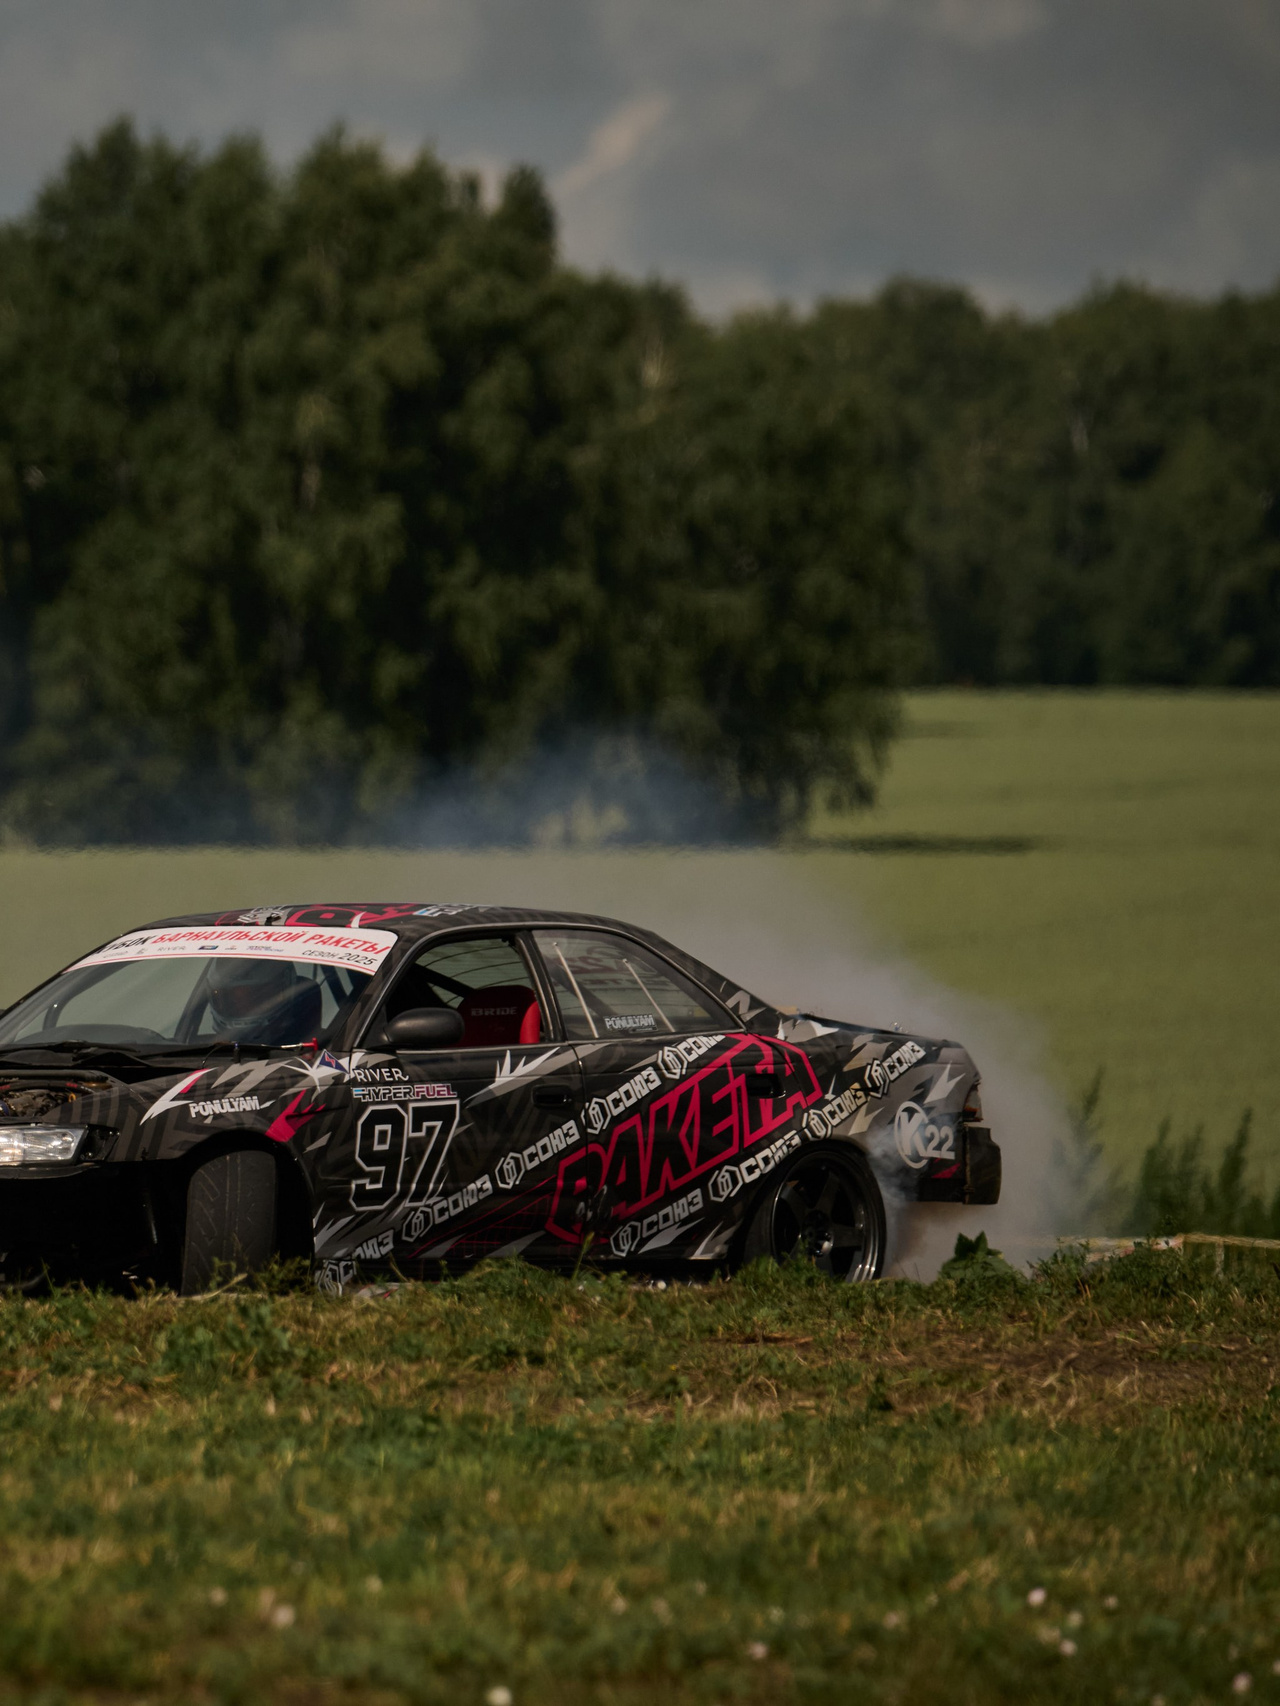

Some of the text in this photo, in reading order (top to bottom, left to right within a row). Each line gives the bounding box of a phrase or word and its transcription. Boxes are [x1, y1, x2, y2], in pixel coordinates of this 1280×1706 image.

[150, 930, 309, 944] БАРНАУЛЬСКОЙ
[302, 934, 391, 955] РАКЕТЫ
[302, 949, 378, 966] СЕЗОН 2025
[471, 1006, 518, 1016] BRIDE
[353, 1068, 409, 1082] RIVER
[189, 1096, 260, 1118] PONULYAM
[433, 1173, 493, 1225] СОЮЗ
[522, 1119, 581, 1171] СОЮЗ
[605, 1066, 662, 1117] СОЮЗ
[546, 1033, 823, 1244] РАКЕТА
[642, 1188, 704, 1238] СОЮЗ
[822, 1083, 868, 1127] СОЮЗ
[882, 1040, 927, 1082] СОЮЗ
[349, 1100, 460, 1211] 97
